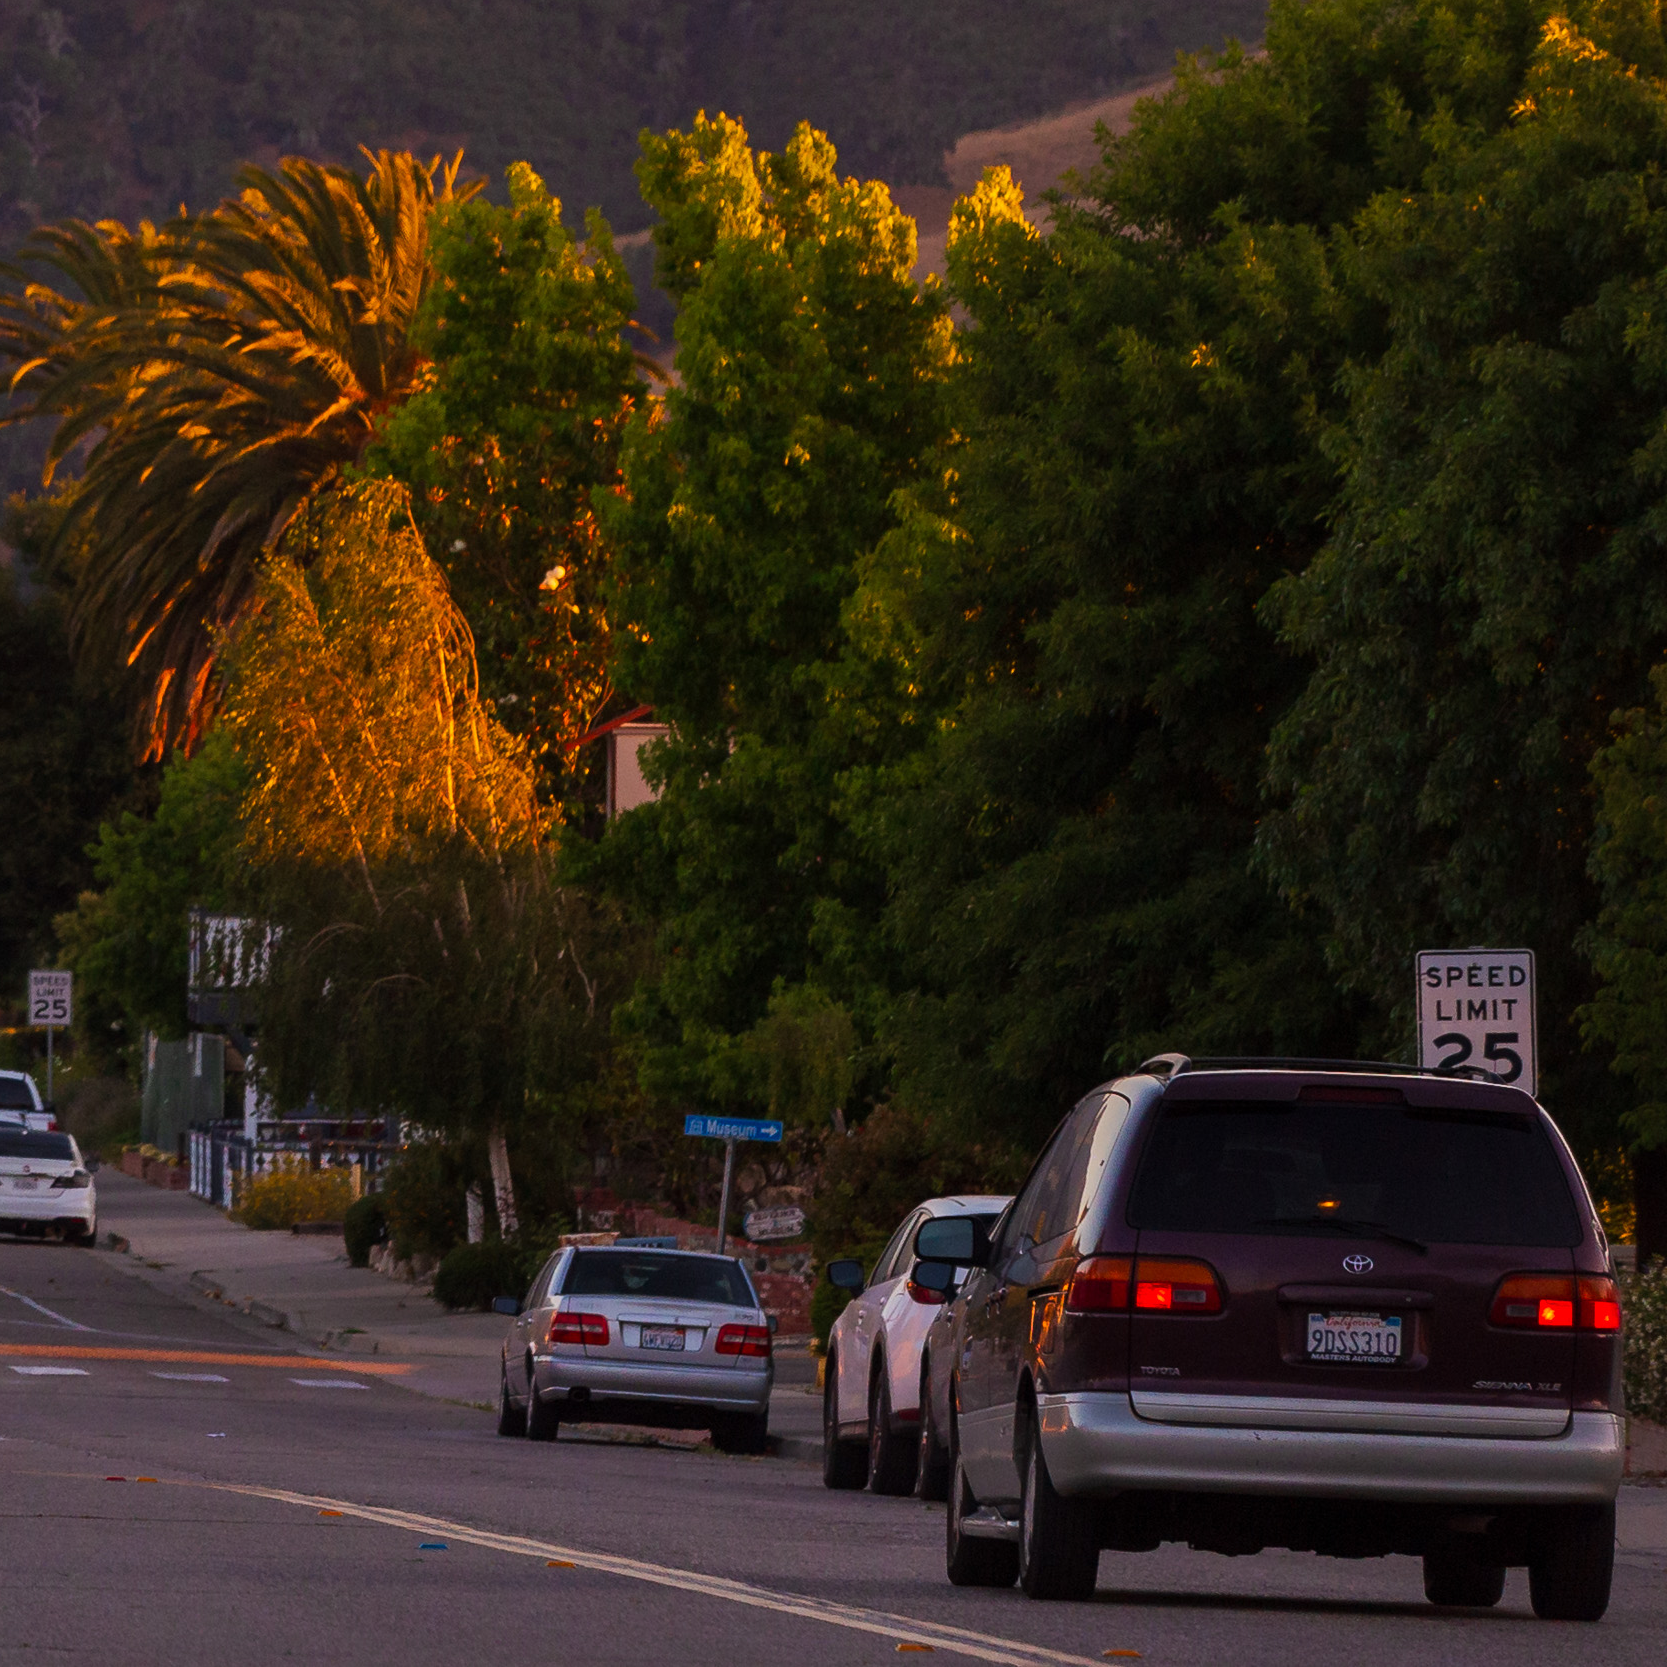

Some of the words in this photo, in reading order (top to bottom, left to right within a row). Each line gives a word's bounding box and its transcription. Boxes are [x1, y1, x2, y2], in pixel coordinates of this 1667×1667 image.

[1425, 965, 1526, 988] SPEED
[36, 988, 65, 997] LIMIT
[34, 999, 68, 1019] 25
[1436, 998, 1518, 1021] LIMIT
[1432, 1032, 1523, 1084] 25
[706, 1118, 757, 1138] Museum
[1325, 1315, 1381, 1330] California
[1311, 1329, 1397, 1356] 9DSS310
[1310, 1352, 1351, 1362] MASTERS
[1352, 1355, 1397, 1364] AUTOBODY
[1140, 1365, 1181, 1376] TOYOTA
[1472, 1380, 1533, 1391] SIENNA
[1536, 1382, 1562, 1391] XLE
